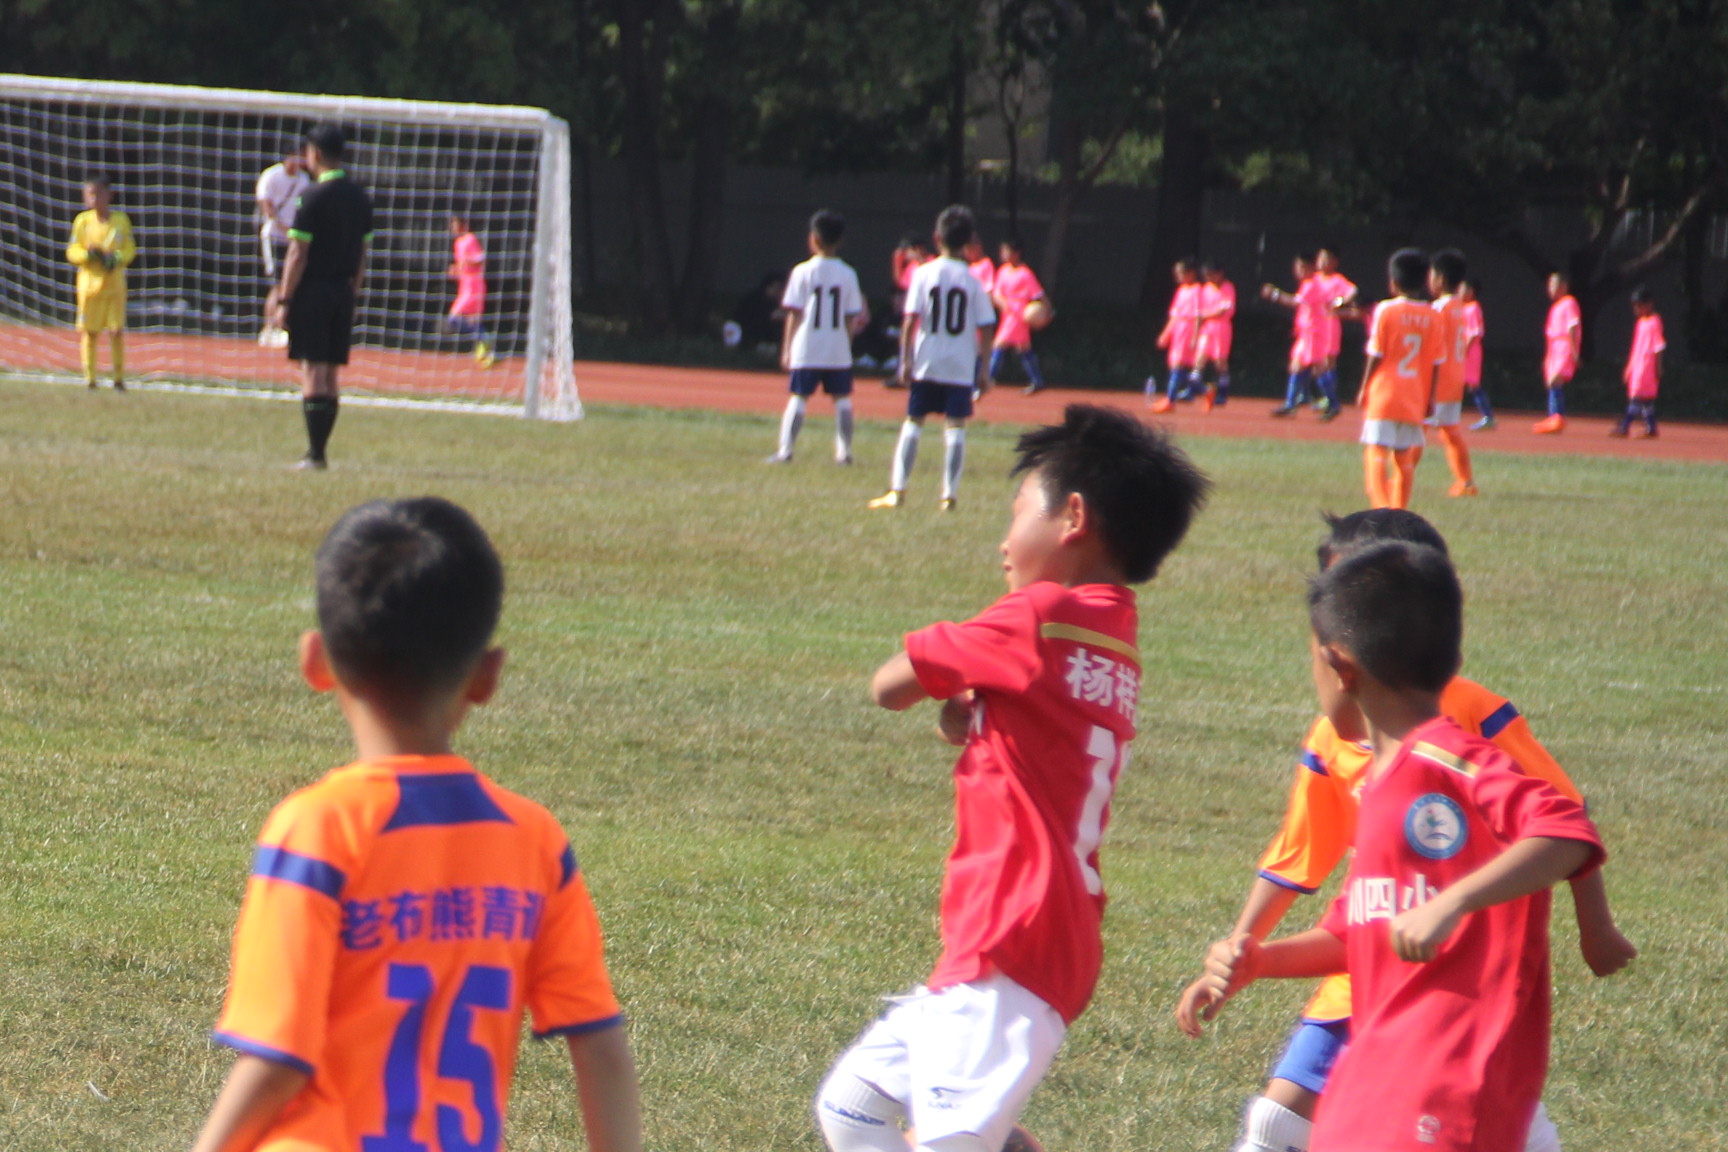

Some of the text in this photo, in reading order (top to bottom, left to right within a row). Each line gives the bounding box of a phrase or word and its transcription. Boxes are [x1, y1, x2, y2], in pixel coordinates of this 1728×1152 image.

[813, 287, 842, 330] 11
[929, 285, 969, 337] 10
[1397, 333, 1423, 378] 2
[1065, 647, 1138, 729] 杨祥
